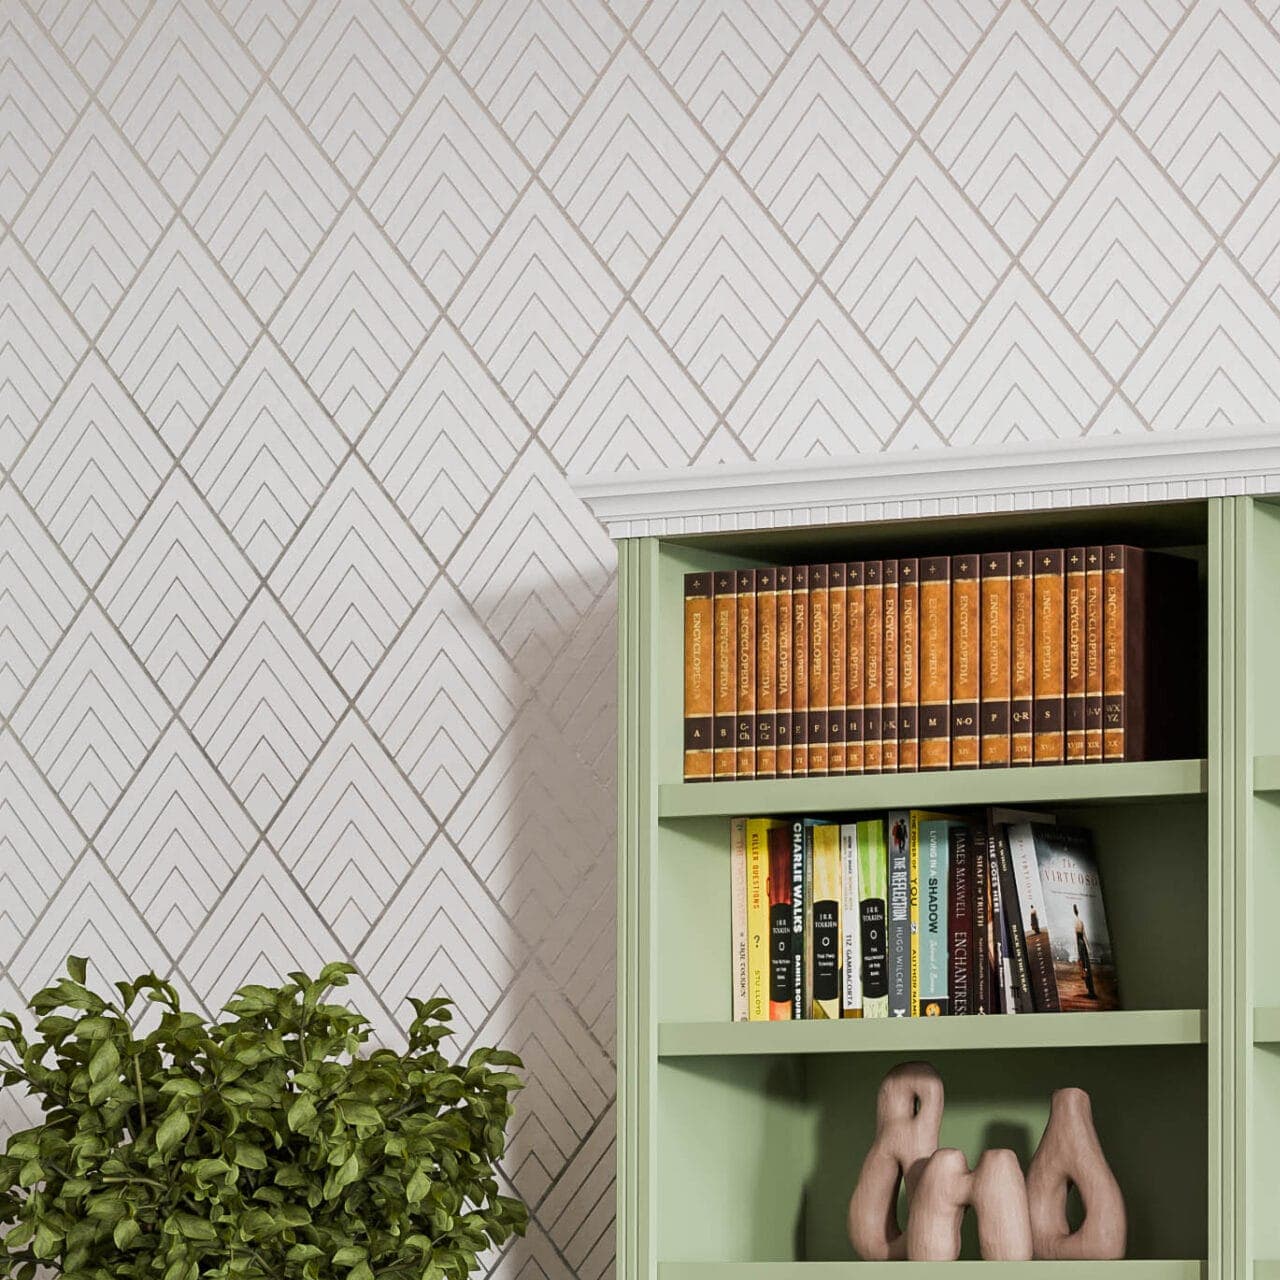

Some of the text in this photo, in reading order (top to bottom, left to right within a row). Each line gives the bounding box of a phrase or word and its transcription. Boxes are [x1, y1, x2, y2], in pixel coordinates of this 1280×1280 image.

[904, 599, 912, 688] ENCYCLOPEDIA
[960, 595, 969, 685] ENCYCLOPEDIA
[990, 594, 999, 684] ENCYCLOPEDIA
[1070, 588, 1079, 679] ENCYCLOPEDIA
[1088, 587, 1097, 677] ENCYCLOPEDIA
[741, 608, 749, 696] ENCYCLOPEDIA
[832, 724, 839, 732] G
[904, 720, 910, 728] L
[928, 718, 937, 726] M
[956, 717, 973, 726] N-O
[991, 714, 997, 722] P
[1013, 712, 1030, 722] Q-R
[1044, 710, 1051, 719] S
[693, 729, 701, 737] A
[720, 728, 726, 736] B
[740, 732, 750, 740] Ch
[779, 726, 786, 734] D
[814, 725, 820, 733] F
[929, 830, 937, 857] LIVING
[792, 822, 804, 934] CHARLIE WALKS
[929, 869, 937, 877] A
[955, 833, 966, 919] JAMES MAXWELL
[976, 855, 984, 885] SHAFT
[990, 861, 998, 888] GOES
[1044, 868, 1099, 888] VIRTUOSO
[892, 857, 907, 921] THE REFLECTION
[910, 877, 918, 907] YOU
[928, 877, 938, 934] SHADOW
[976, 895, 984, 927] TRUTH
[896, 926, 904, 995] HUGO WILCKEN
